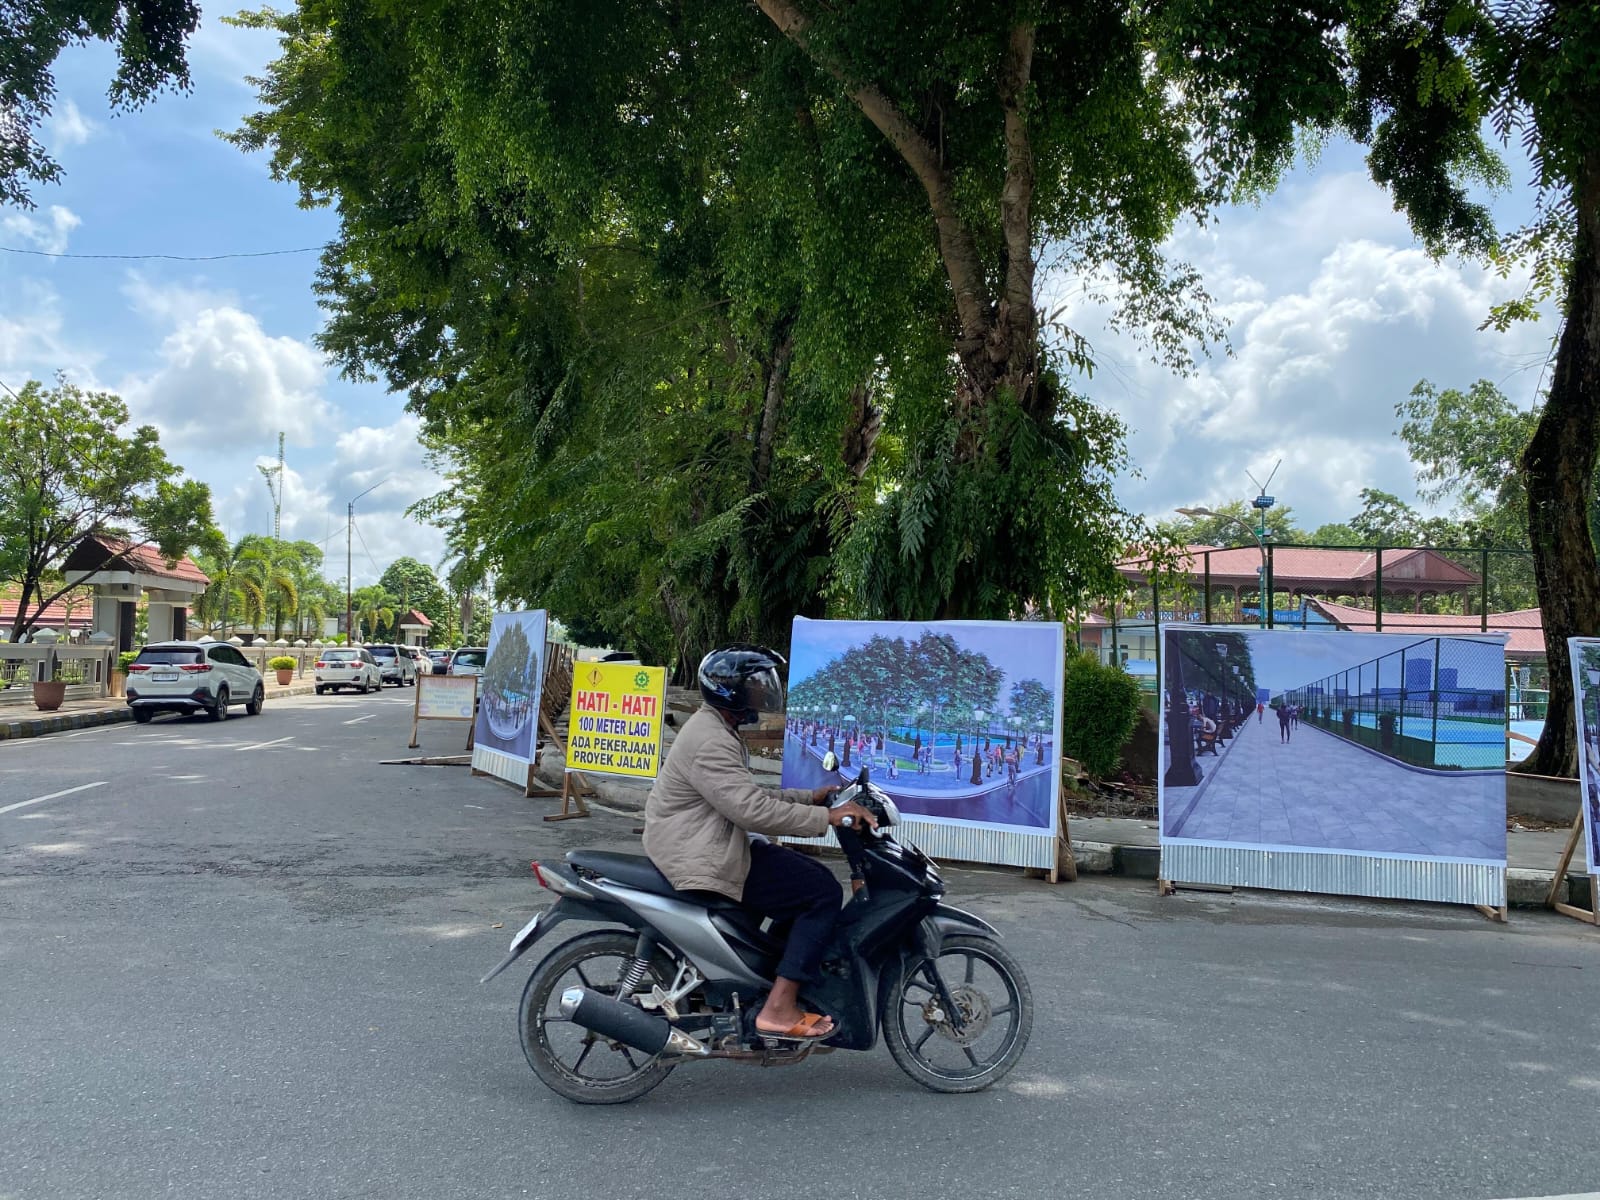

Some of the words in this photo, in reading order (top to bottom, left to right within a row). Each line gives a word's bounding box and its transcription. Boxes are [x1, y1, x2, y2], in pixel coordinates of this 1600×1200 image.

[576, 691, 610, 712] HATI
[621, 695, 657, 716] HATI
[579, 717, 594, 731] 100
[596, 718, 626, 735] METER
[629, 721, 650, 737] LAGI
[571, 736, 590, 748] ADA
[594, 738, 655, 755] PEKERJAAN
[574, 751, 613, 766] PROYEK
[617, 756, 650, 770] JALAN
